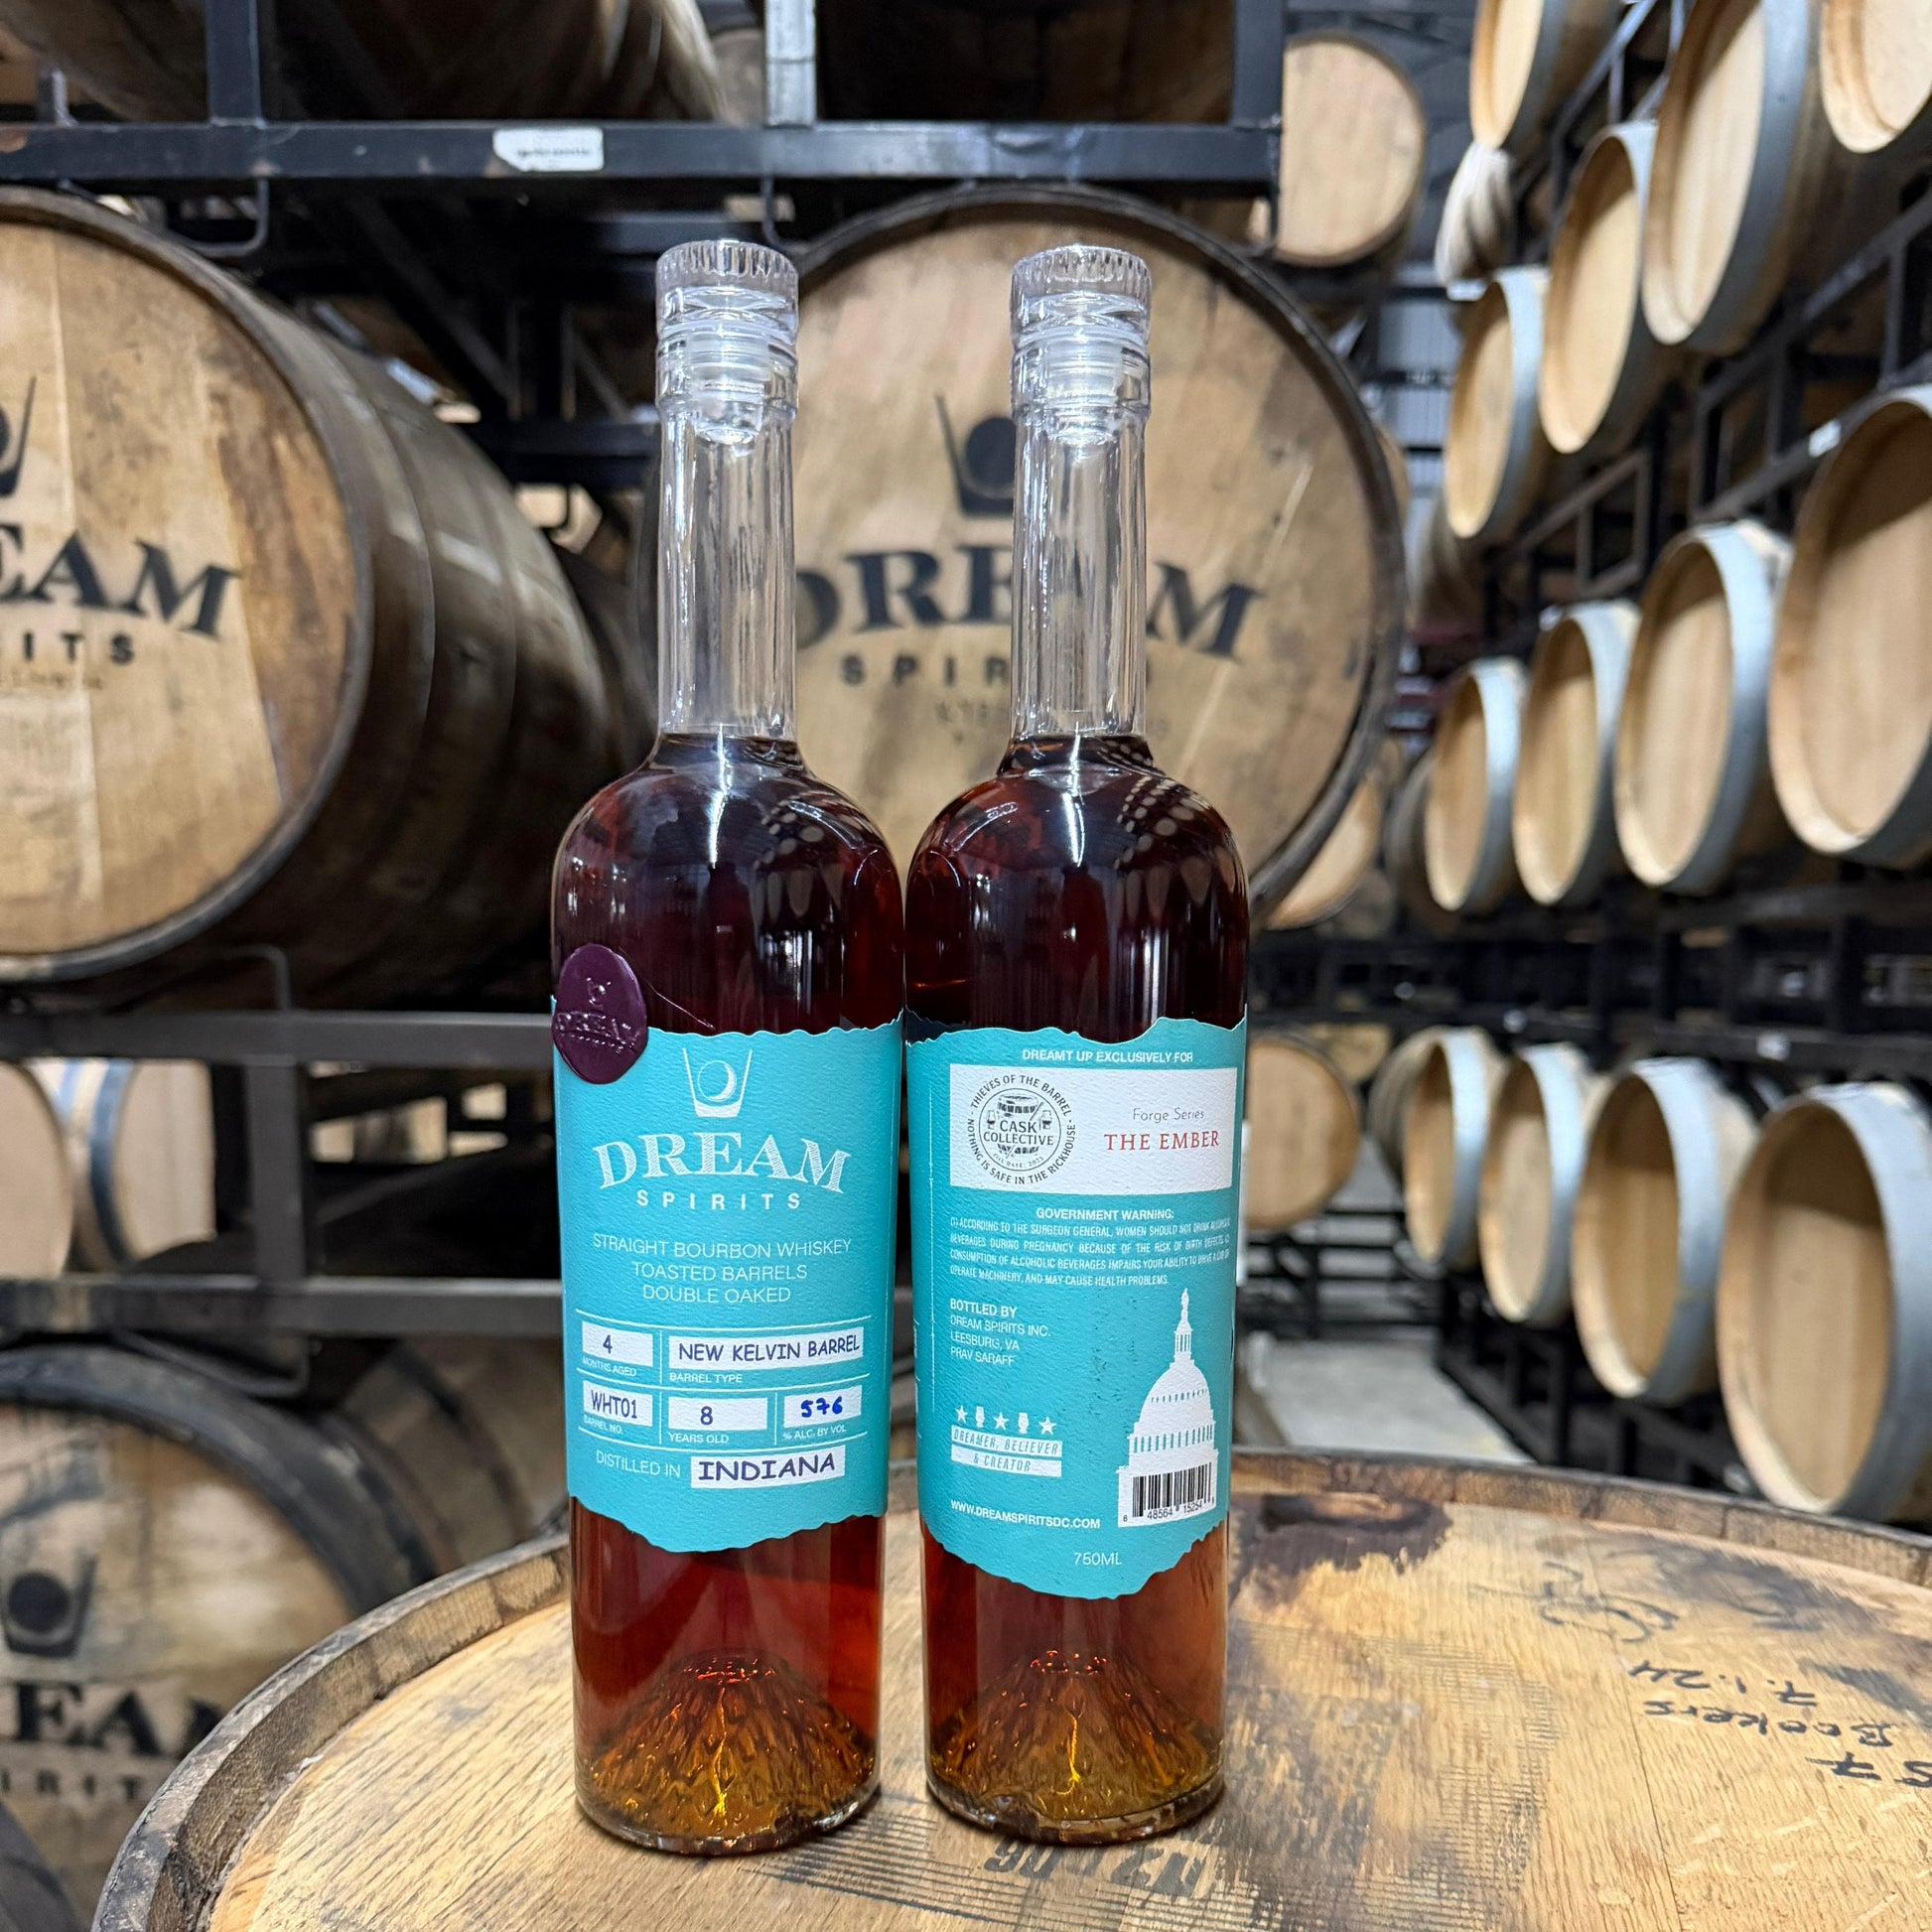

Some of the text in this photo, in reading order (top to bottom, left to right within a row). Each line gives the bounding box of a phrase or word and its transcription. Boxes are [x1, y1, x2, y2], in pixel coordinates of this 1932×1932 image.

[1022, 1048, 1193, 1063] DREAMT UP EXCLUSIVELY FOR
[971, 1074, 1072, 1117] THIEVES OF THE BARREL
[1133, 1107, 1205, 1124] Forge Series
[1000, 1119, 1037, 1133] CASK
[983, 1131, 1054, 1146] COLLECTIVE
[1104, 1130, 1219, 1151] THE EMBER
[967, 1118, 983, 1162] NOTHING
[981, 1160, 991, 1171] IS
[989, 1168, 1012, 1183] SAFE
[1028, 1170, 1048, 1183] THE
[1046, 1124, 1075, 1174] RICKHOUSE
[592, 1131, 852, 1194] DREAM
[635, 1188, 801, 1210] SPIRITS
[1035, 1207, 1174, 1220] GOVERNMENT WARNING:
[959, 1218, 999, 1231] ACCORDING
[1000, 1222, 1010, 1232] TO
[1014, 1223, 1028, 1233] THE
[1031, 1224, 1070, 1236] SURGEON
[1116, 1226, 1147, 1237] WOMEN
[1150, 1225, 1177, 1236] SHOULD
[593, 1231, 852, 1260] STRAIGHT BOURBON WHISKEY
[950, 1234, 986, 1247] BEVERAGES
[990, 1238, 1019, 1250] DURING
[1024, 1240, 1074, 1253] PREGNANCY
[1078, 1243, 1116, 1254] BECAUSE
[1121, 1243, 1131, 1254] OF
[1136, 1243, 1151, 1253] THE
[1155, 1241, 1171, 1252] RISK
[1173, 1240, 1182, 1251] OF
[950, 1249, 997, 1265] CONSUMPTION
[999, 1255, 1009, 1266] OF
[1011, 1256, 1055, 1268] ALCOHOLIC
[1057, 1258, 1106, 1270] BEVERAGES
[1108, 1259, 1141, 1270] IMPAIRS
[1143, 1258, 1164, 1270] YOUR
[1164, 1256, 1188, 1269] ABILITY
[1188, 1255, 1196, 1265] TO
[631, 1261, 808, 1282] TOASTED BARRELS
[950, 1265, 978, 1278] OPERATE
[978, 1268, 1024, 1283] MACHINERY,
[1025, 1273, 1043, 1284] AND
[1044, 1275, 1063, 1285] MAY
[1064, 1275, 1093, 1286] CAUSE
[1095, 1276, 1126, 1287] HEALTH
[642, 1284, 791, 1304] DOUBLE OAKED
[950, 1298, 1018, 1318] BOTTLED BY
[950, 1314, 1051, 1337] DREAM SPIRITS INC.
[602, 1334, 614, 1354] 4
[678, 1334, 861, 1362] NEW KELVIN BARREL
[950, 1330, 1021, 1350] LEESBURG, VA
[950, 1346, 1017, 1366] PRAV SARAFF
[582, 1356, 637, 1377] MONTHS AGED
[669, 1372, 744, 1384] BARREL TYPE
[583, 1414, 623, 1435] BARREL NO.
[700, 1406, 714, 1426] 8
[668, 1432, 730, 1445] YEARS OLD
[794, 1429, 816, 1440] ALC.
[817, 1427, 829, 1437] BY
[953, 1429, 1059, 1455] DREAMER, BELIEVER
[596, 1449, 681, 1478] DISTILLED IN
[698, 1452, 835, 1481] INDIANA
[973, 1452, 1032, 1472] & CREATOR
[950, 1499, 1101, 1529] WWW.DREAMSPIRITSDC.COM
[1147, 1509, 1173, 1520] 48564
[1074, 1552, 1123, 1566] 750ML
